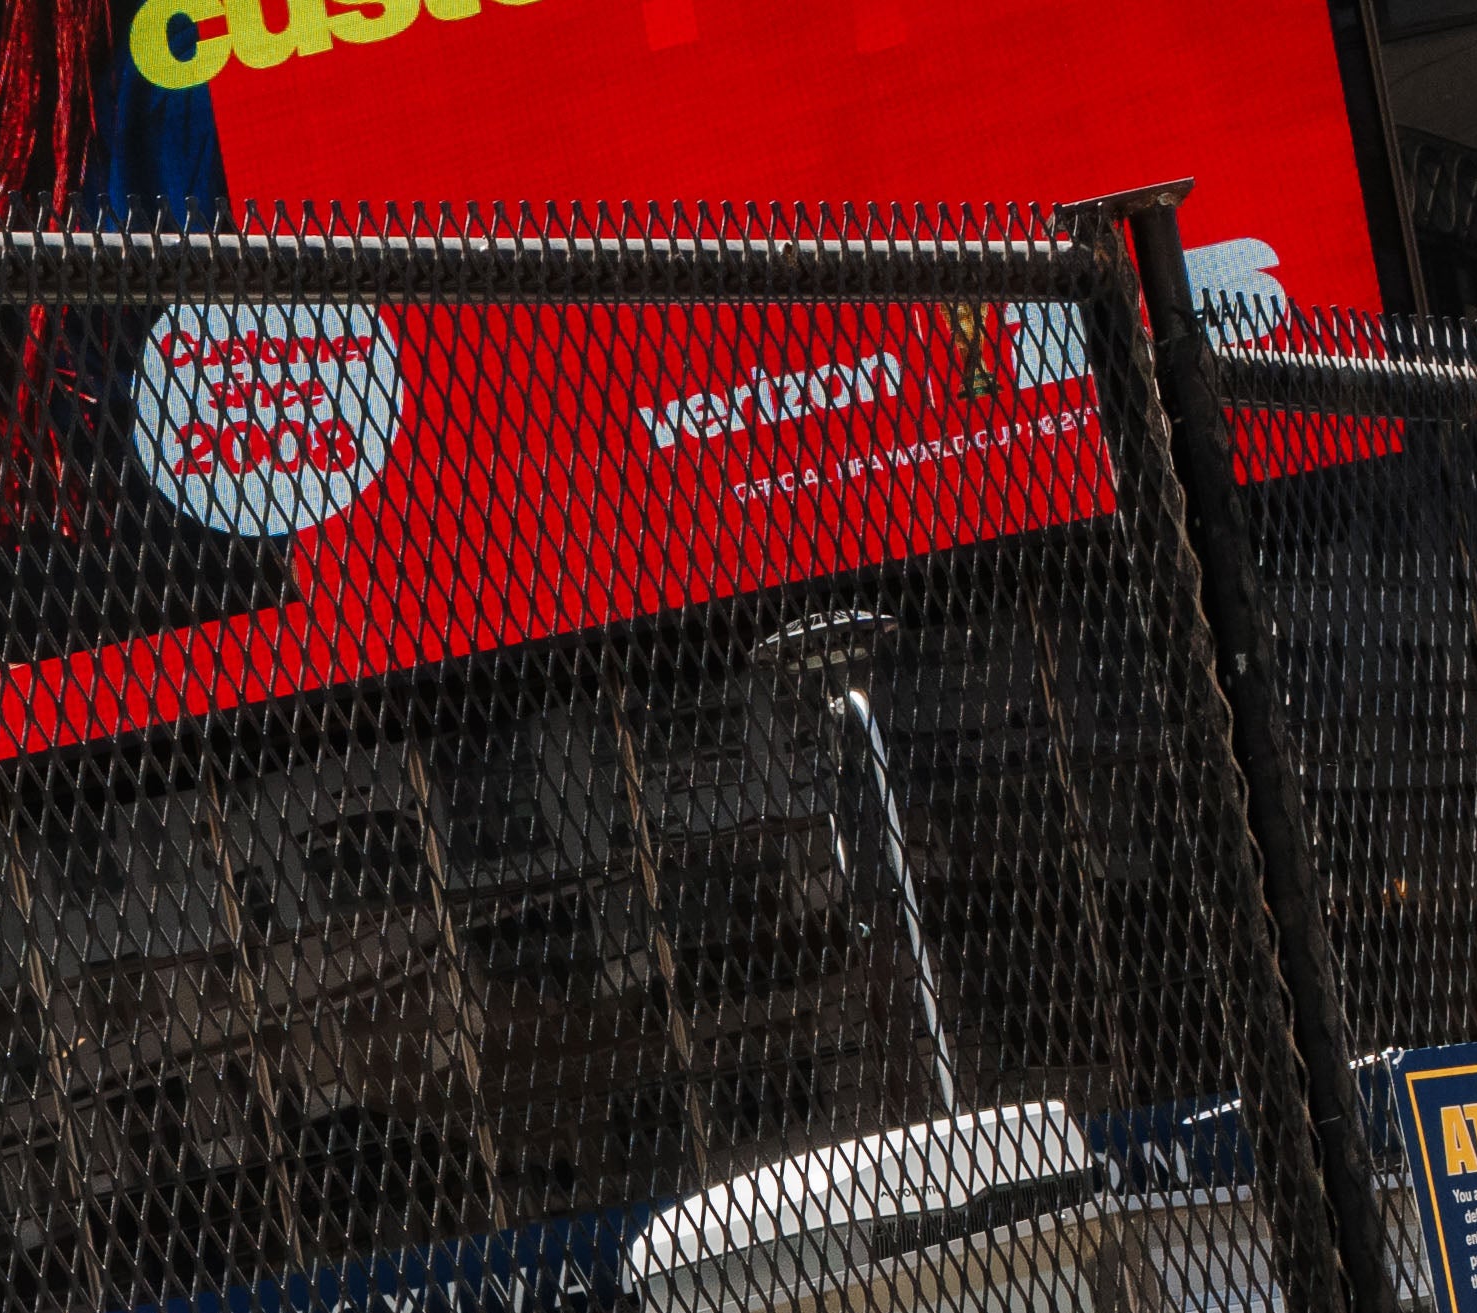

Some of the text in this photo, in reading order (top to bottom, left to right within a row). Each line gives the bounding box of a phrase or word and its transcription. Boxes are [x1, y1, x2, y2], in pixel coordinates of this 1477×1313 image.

[160, 330, 373, 368] Customer
[208, 372, 325, 409] since
[638, 352, 901, 449] verizon
[174, 419, 356, 475] 2008
[1452, 1189, 1472, 1203] You
